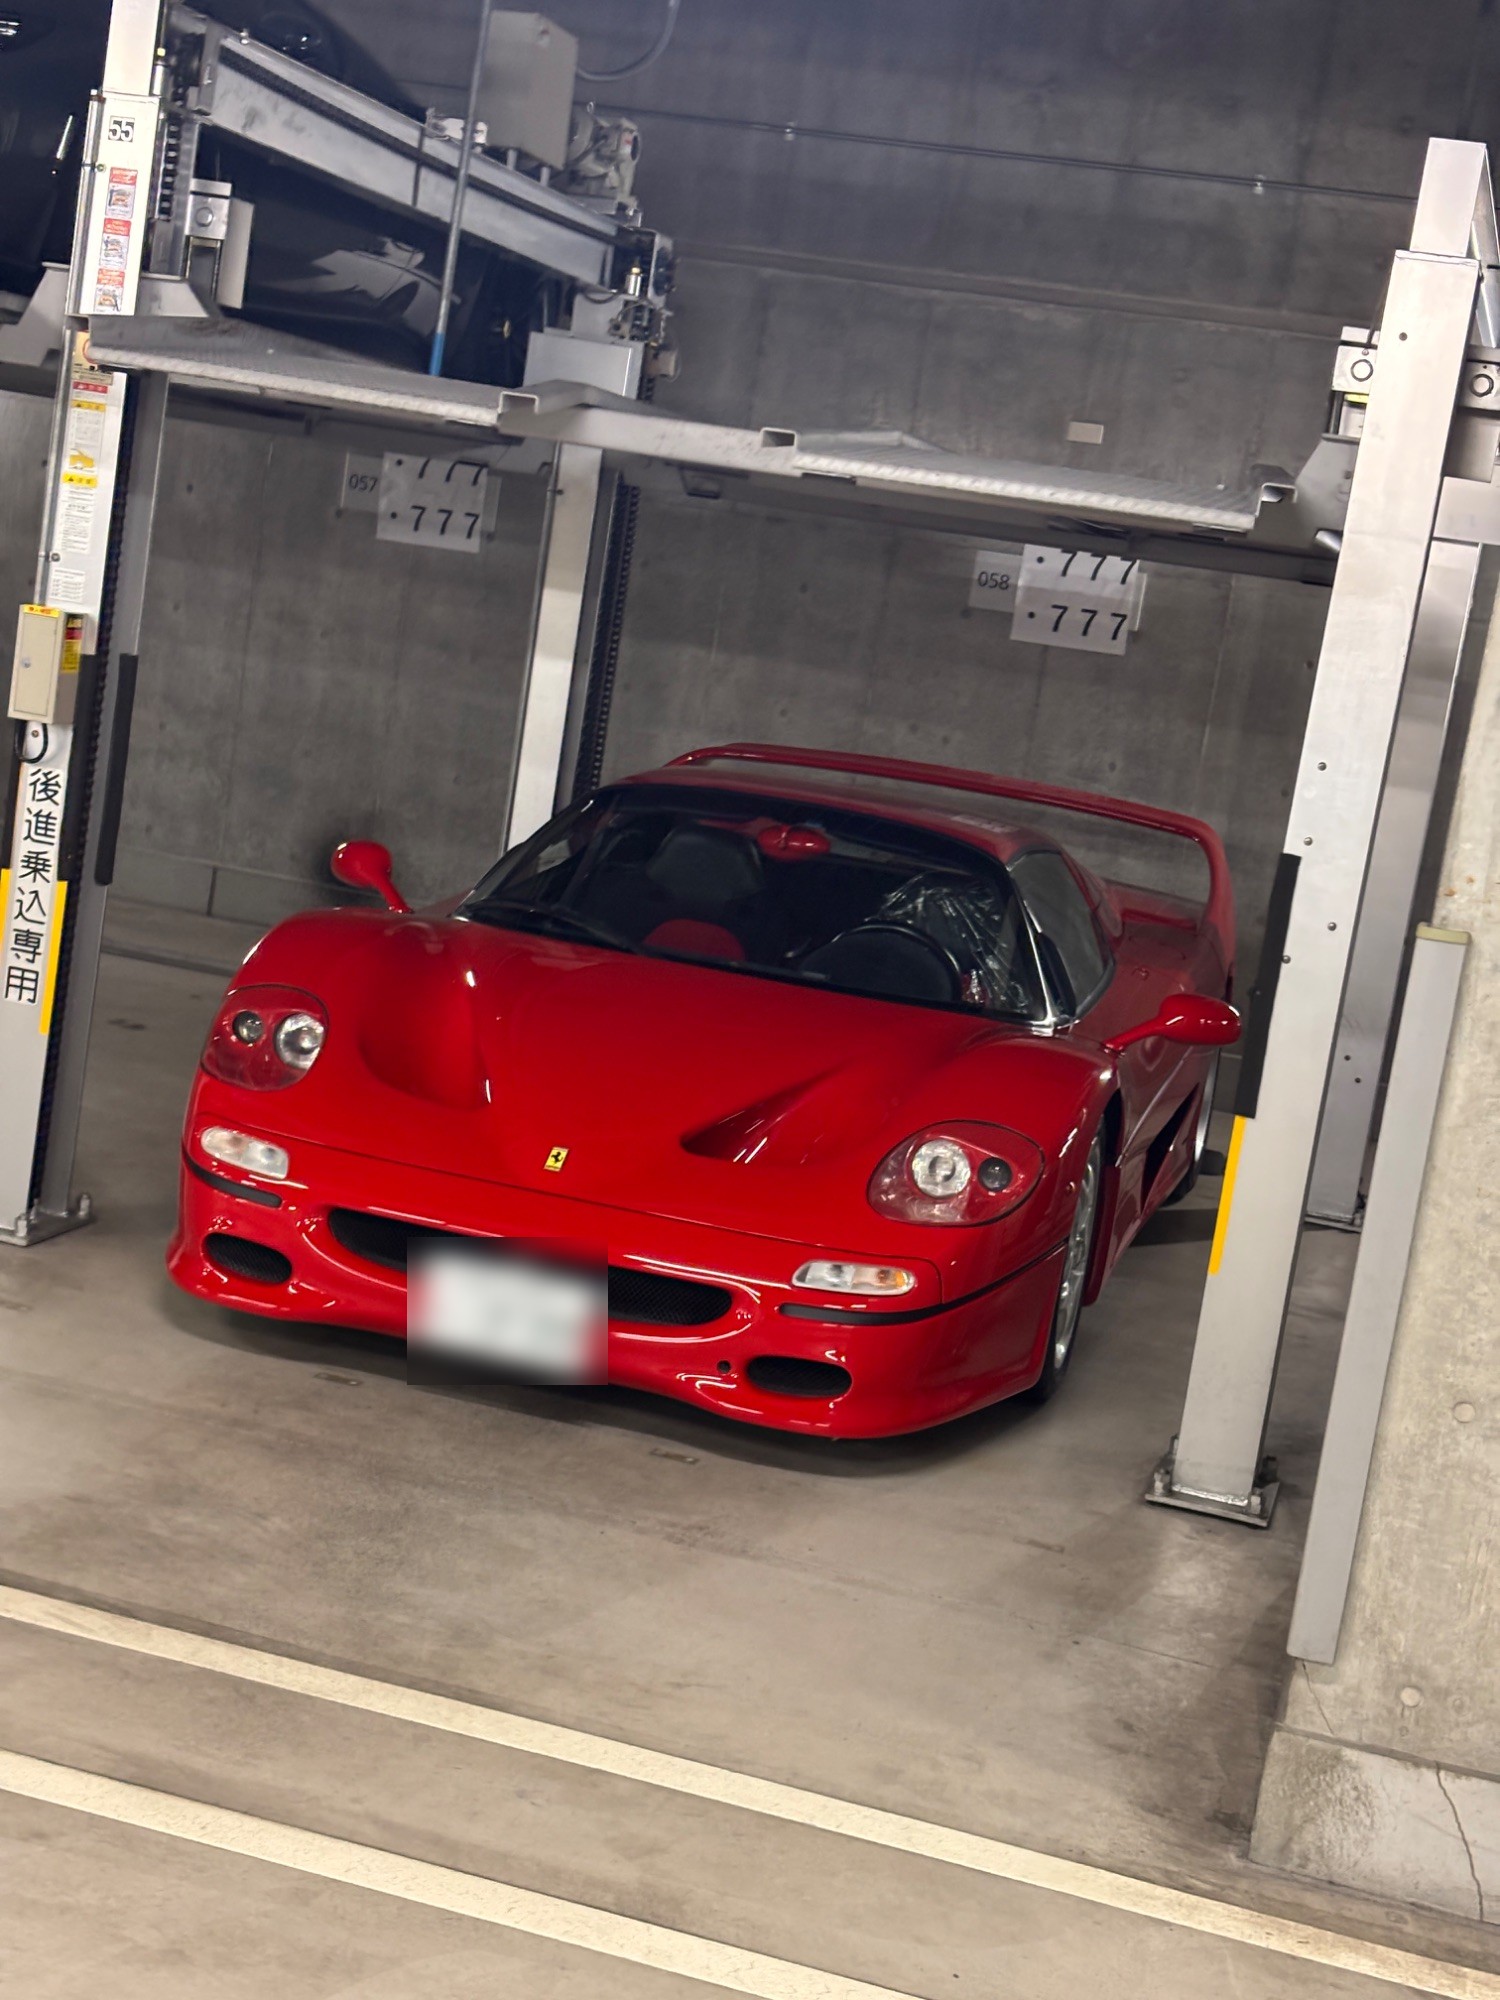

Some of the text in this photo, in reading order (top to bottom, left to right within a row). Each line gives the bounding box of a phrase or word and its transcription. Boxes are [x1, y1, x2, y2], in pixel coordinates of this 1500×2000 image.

[108, 117, 134, 142] 55
[349, 473, 378, 493] 057
[977, 571, 1010, 591] 058
[4, 768, 62, 1004] 後進乗込専用
